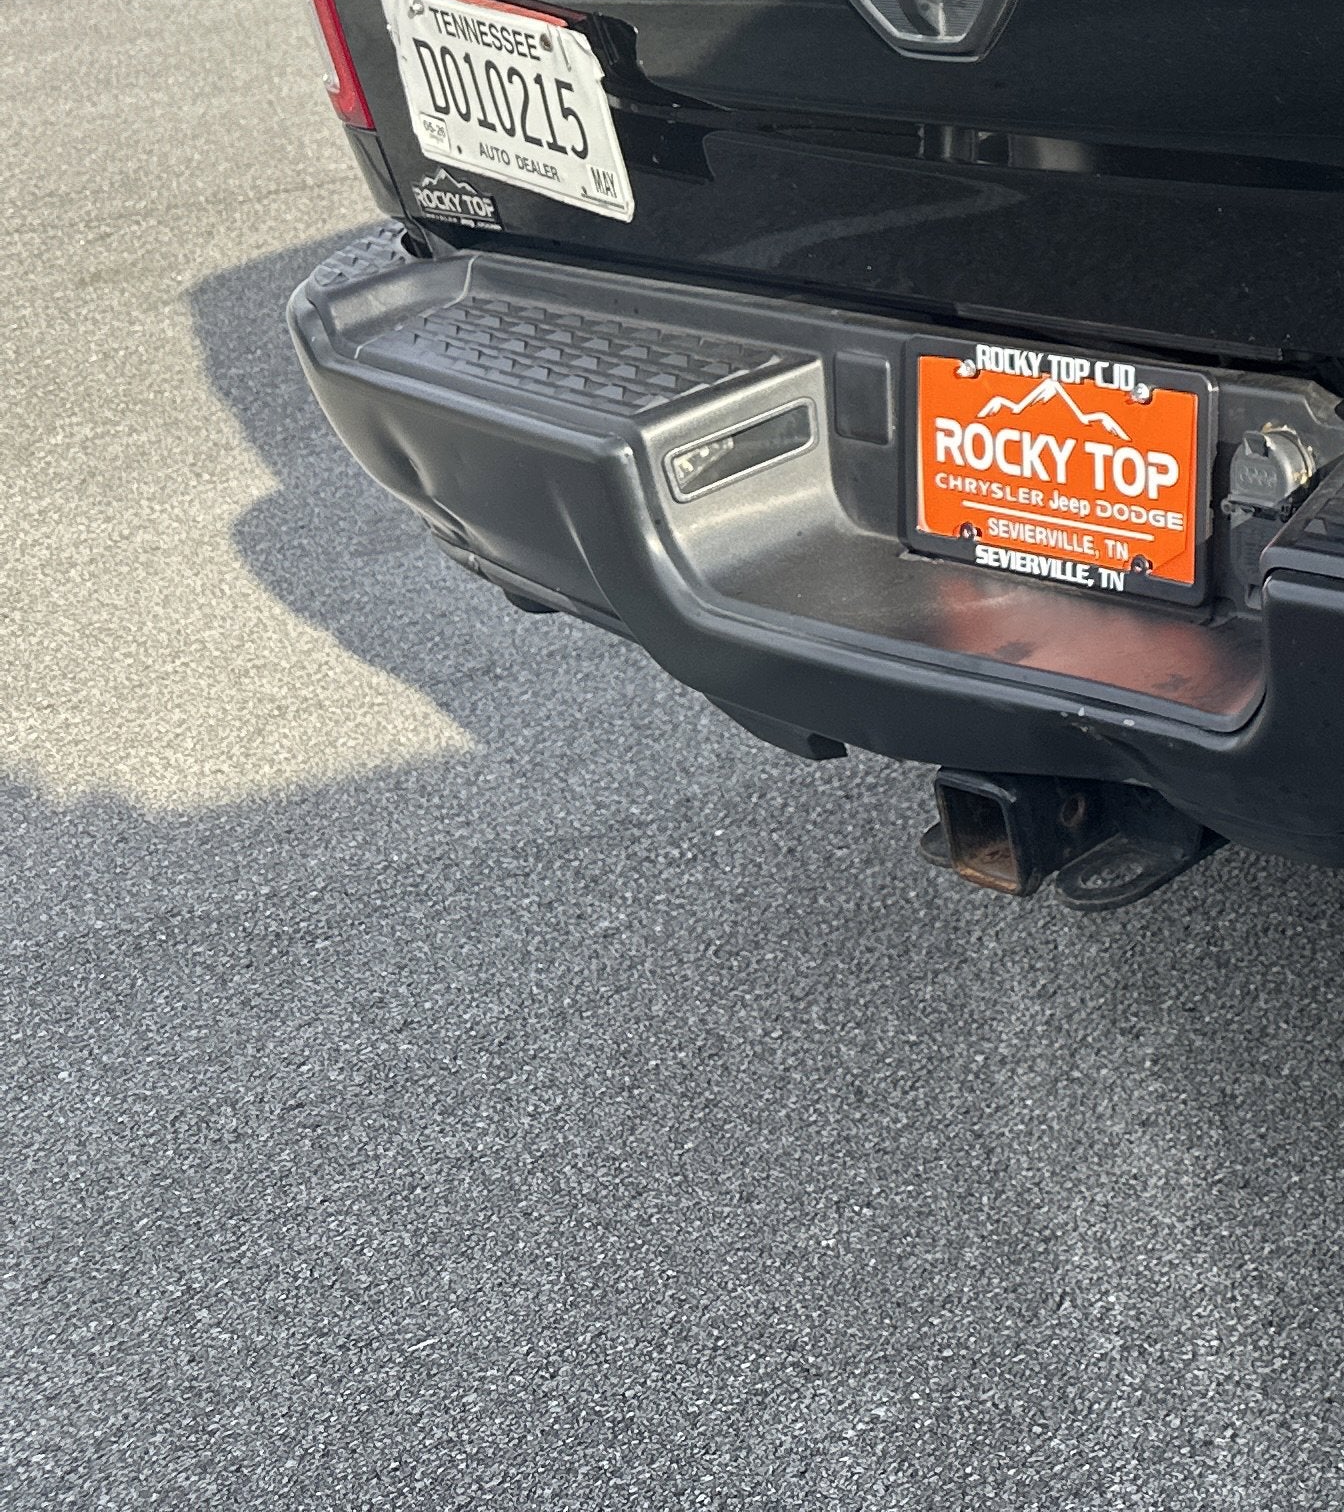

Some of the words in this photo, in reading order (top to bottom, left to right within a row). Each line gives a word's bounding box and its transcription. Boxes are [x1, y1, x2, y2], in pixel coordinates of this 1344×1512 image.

[428, 7, 541, 61] TENNESSEE
[412, 37, 589, 161] D010215
[479, 142, 510, 166] AUTO
[516, 154, 560, 183] DEALER
[590, 168, 618, 199] MAY
[412, 186, 462, 213] ROCKY
[462, 194, 495, 218] TOP
[975, 343, 1044, 378] ROCKY
[1047, 354, 1091, 386] TOP
[934, 416, 1077, 485] ROCKY
[1084, 440, 1179, 500] TOP
[934, 472, 1045, 507] CHRYSLER
[1048, 489, 1091, 518] Jeep
[1095, 499, 1185, 531] DODGE
[987, 517, 1101, 560] SEVIERVILLE,
[1104, 539, 1130, 562] TN
[974, 544, 1096, 588] SEVIERVILLE,
[1098, 567, 1125, 592] TN
